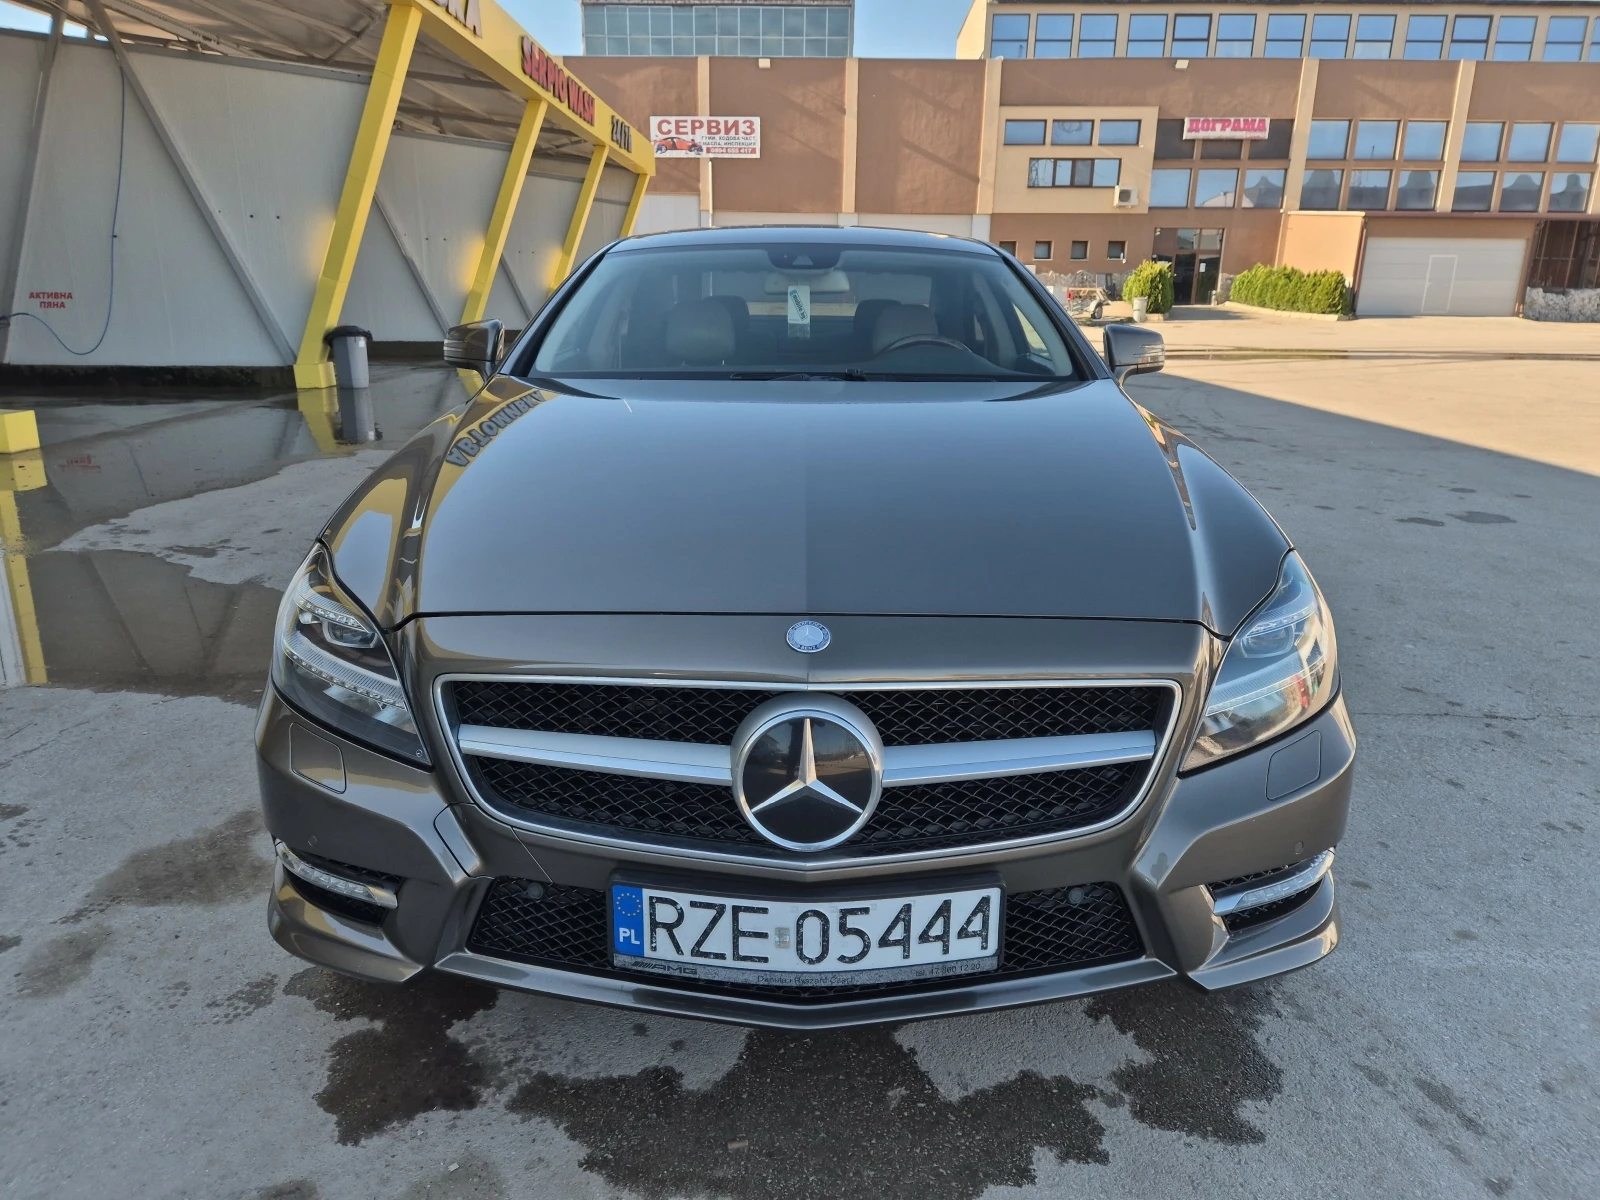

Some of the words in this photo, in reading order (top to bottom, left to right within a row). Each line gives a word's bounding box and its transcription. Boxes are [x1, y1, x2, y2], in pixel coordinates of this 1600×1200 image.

[521, 35, 566, 103] SERPIO
[567, 76, 595, 127] WASH
[657, 119, 756, 136] СЕРВИЗ
[1187, 118, 1267, 133] ДОГРАМА
[28, 292, 73, 300] АКТИВНА
[39, 301, 66, 309] ПЯНА
[619, 927, 641, 945] PL
[649, 895, 770, 964] RZE
[795, 895, 991, 965] 05444
[651, 963, 698, 975] AMG
[971, 962, 981, 971] 20
